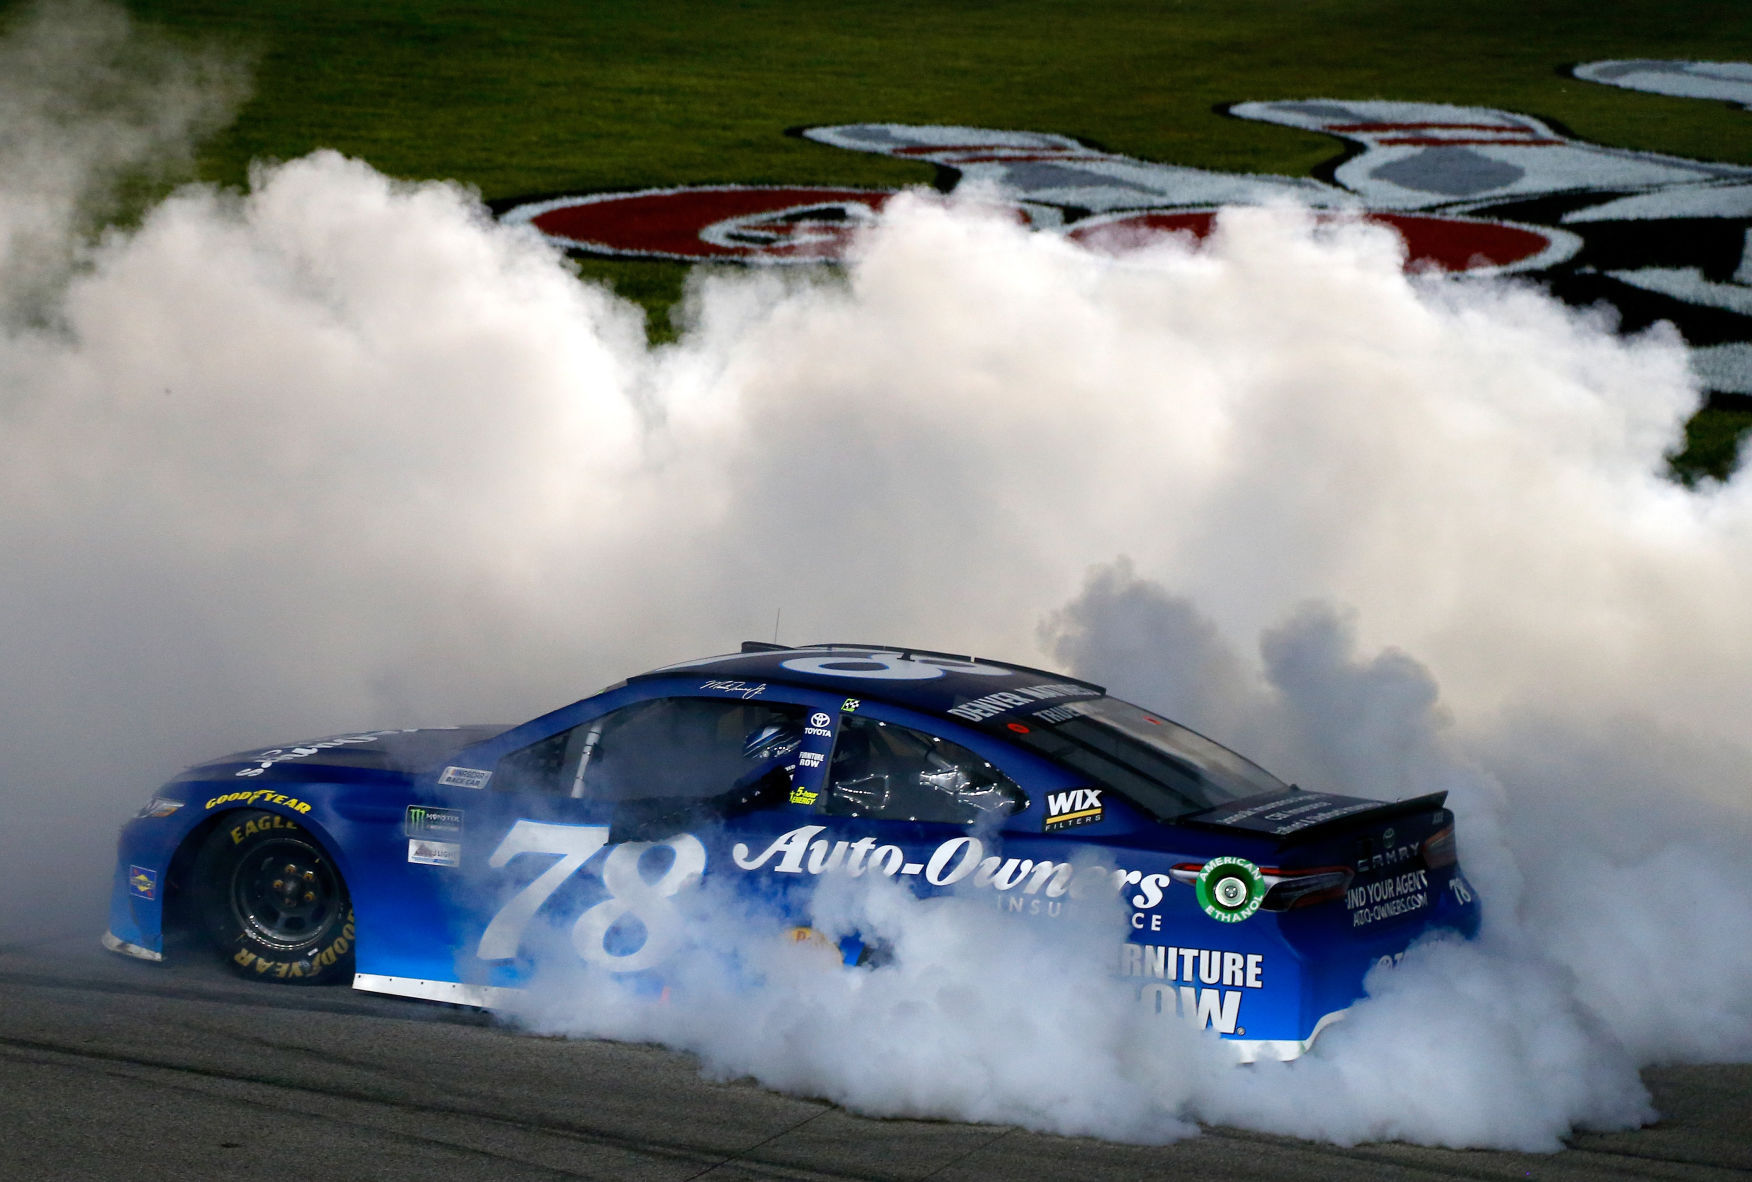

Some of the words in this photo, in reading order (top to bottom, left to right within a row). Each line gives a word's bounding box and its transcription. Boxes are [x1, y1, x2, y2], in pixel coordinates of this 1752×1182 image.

[947, 691, 1026, 723] DENVER
[1032, 702, 1082, 724] TRUE
[804, 727, 832, 738] TOYOTA
[799, 759, 820, 768] ROW
[205, 788, 312, 815] GOODYEAR
[1047, 788, 1102, 816] WIX
[1045, 814, 1101, 832] FILTERS
[1200, 856, 1262, 882] AMERICAN
[1357, 842, 1420, 872] CAMRY
[476, 819, 707, 973] 78
[1346, 887, 1367, 911] IND
[1366, 877, 1395, 903] YOUR
[1395, 869, 1428, 895] AGENT
[1449, 876, 1472, 906] 78
[994, 894, 1163, 932] INSUCE
[1205, 895, 1263, 923] ETHANOL
[1119, 942, 1264, 989] RNITURE
[1140, 982, 1243, 1035] OW
